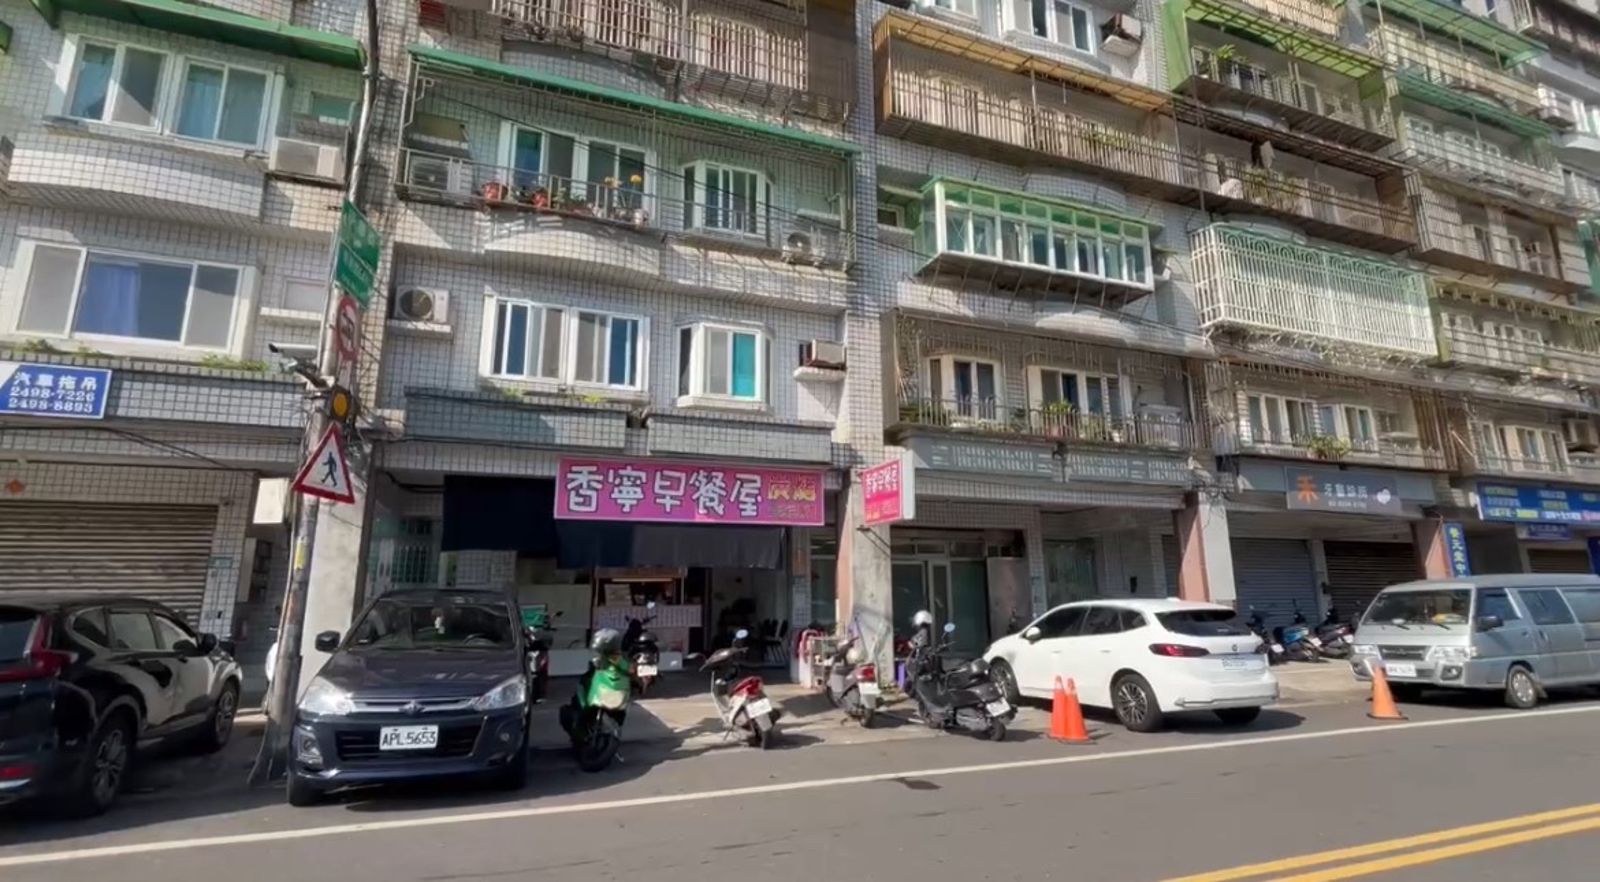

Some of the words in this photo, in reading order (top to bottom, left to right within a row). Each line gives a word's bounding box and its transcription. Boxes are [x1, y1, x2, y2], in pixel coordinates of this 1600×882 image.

[14, 372, 97, 390] 汽車拖吊
[9, 386, 95, 403] 2498-7226
[566, 465, 762, 517] 香寧早餐屋
